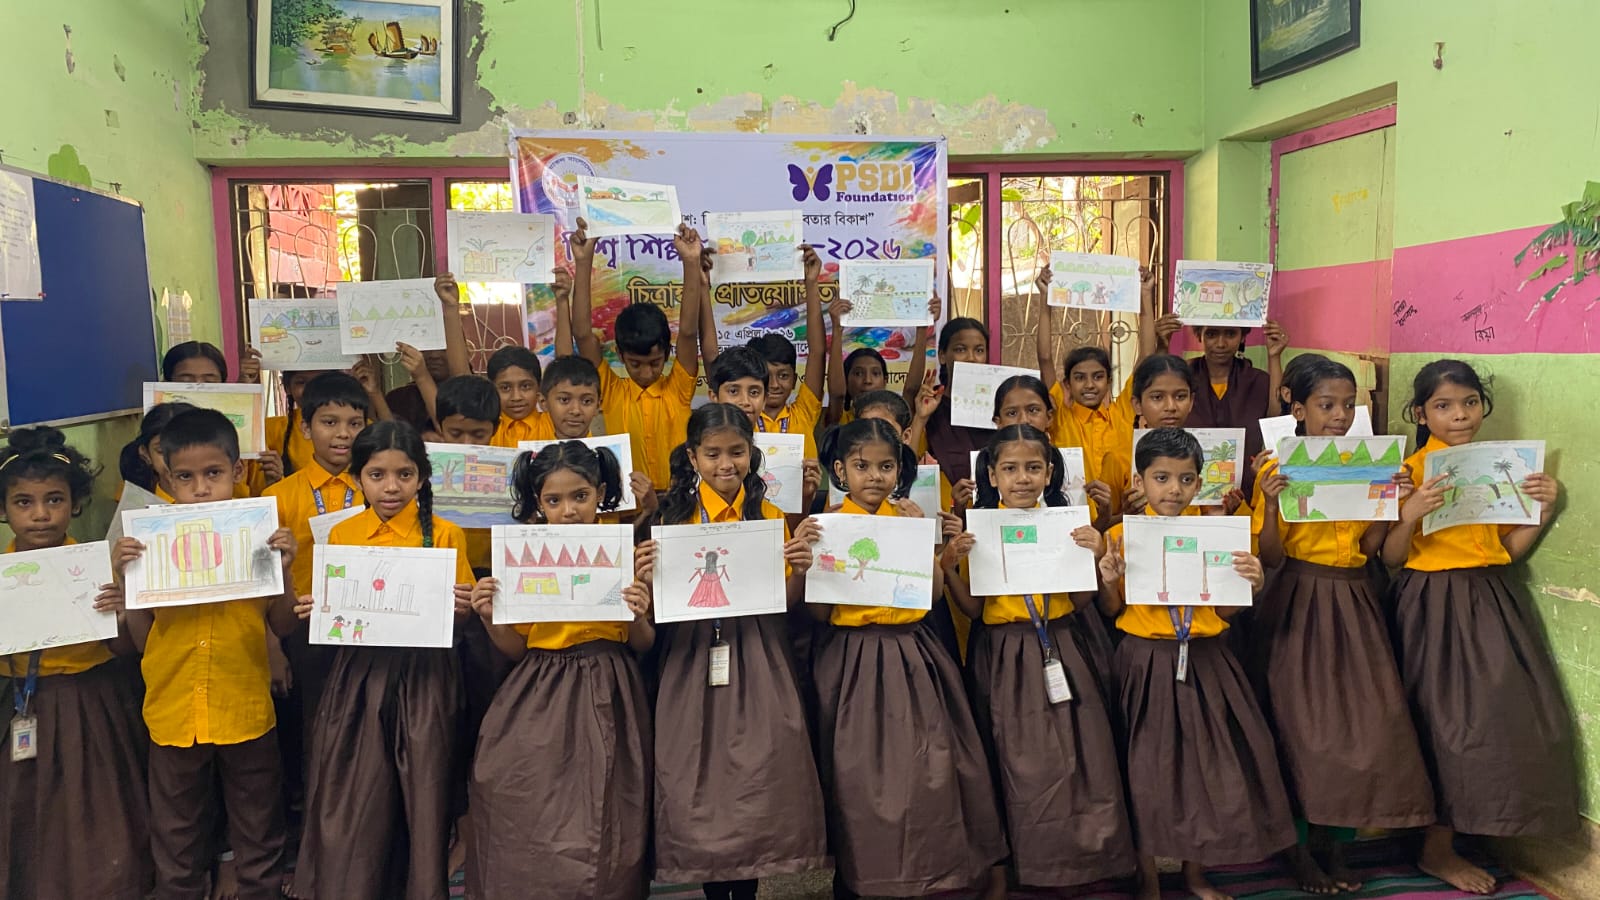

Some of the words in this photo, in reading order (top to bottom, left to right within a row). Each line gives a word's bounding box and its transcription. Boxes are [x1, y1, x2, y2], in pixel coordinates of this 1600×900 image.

[835, 163, 914, 192] PSDI
[836, 191, 914, 203] Foundation
[802, 213, 831, 226] বতার
[627, 275, 684, 308] চিত্রা
[717, 329, 730, 340] ১৫
[735, 326, 763, 340] এপ্রিল
